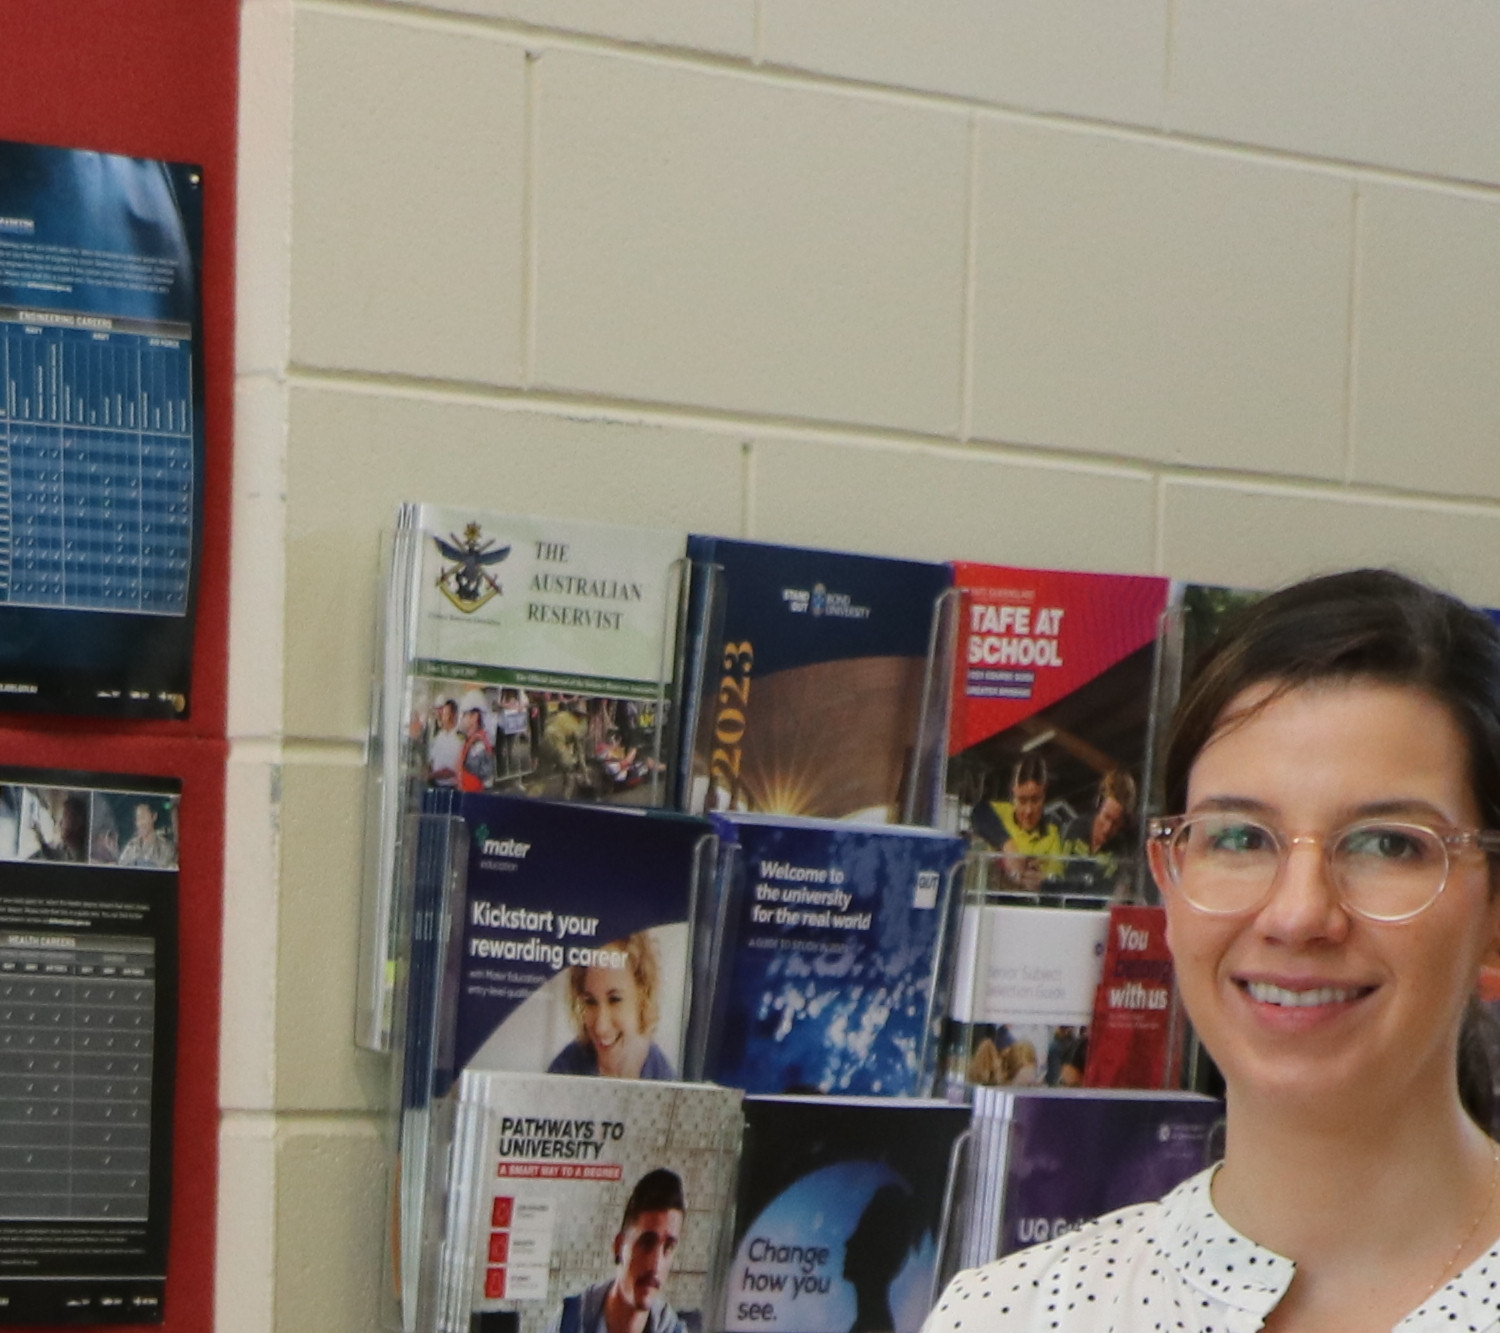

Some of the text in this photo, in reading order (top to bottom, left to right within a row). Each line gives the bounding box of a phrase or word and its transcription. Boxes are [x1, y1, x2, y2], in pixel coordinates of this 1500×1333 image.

[535, 542, 569, 563] THE
[530, 574, 642, 600] AUSTRALIAN
[528, 604, 623, 630] RESERVIST
[970, 605, 1064, 635] TAFE AT
[968, 637, 1063, 667] SCHOOL
[483, 839, 530, 859] mater
[761, 861, 844, 884] Welcome to
[757, 883, 852, 912] the university
[472, 902, 598, 938] Kickstart your
[752, 906, 871, 930] for the real world
[1118, 925, 1148, 950] You
[470, 939, 629, 970] rewarding career
[1109, 983, 1167, 1009] with us
[501, 1117, 624, 1141] PATHWAYS TO
[499, 1138, 605, 1160] UNIVERSITY
[749, 1238, 830, 1276] Change
[743, 1268, 830, 1299] how you
[738, 1302, 777, 1321] see.
